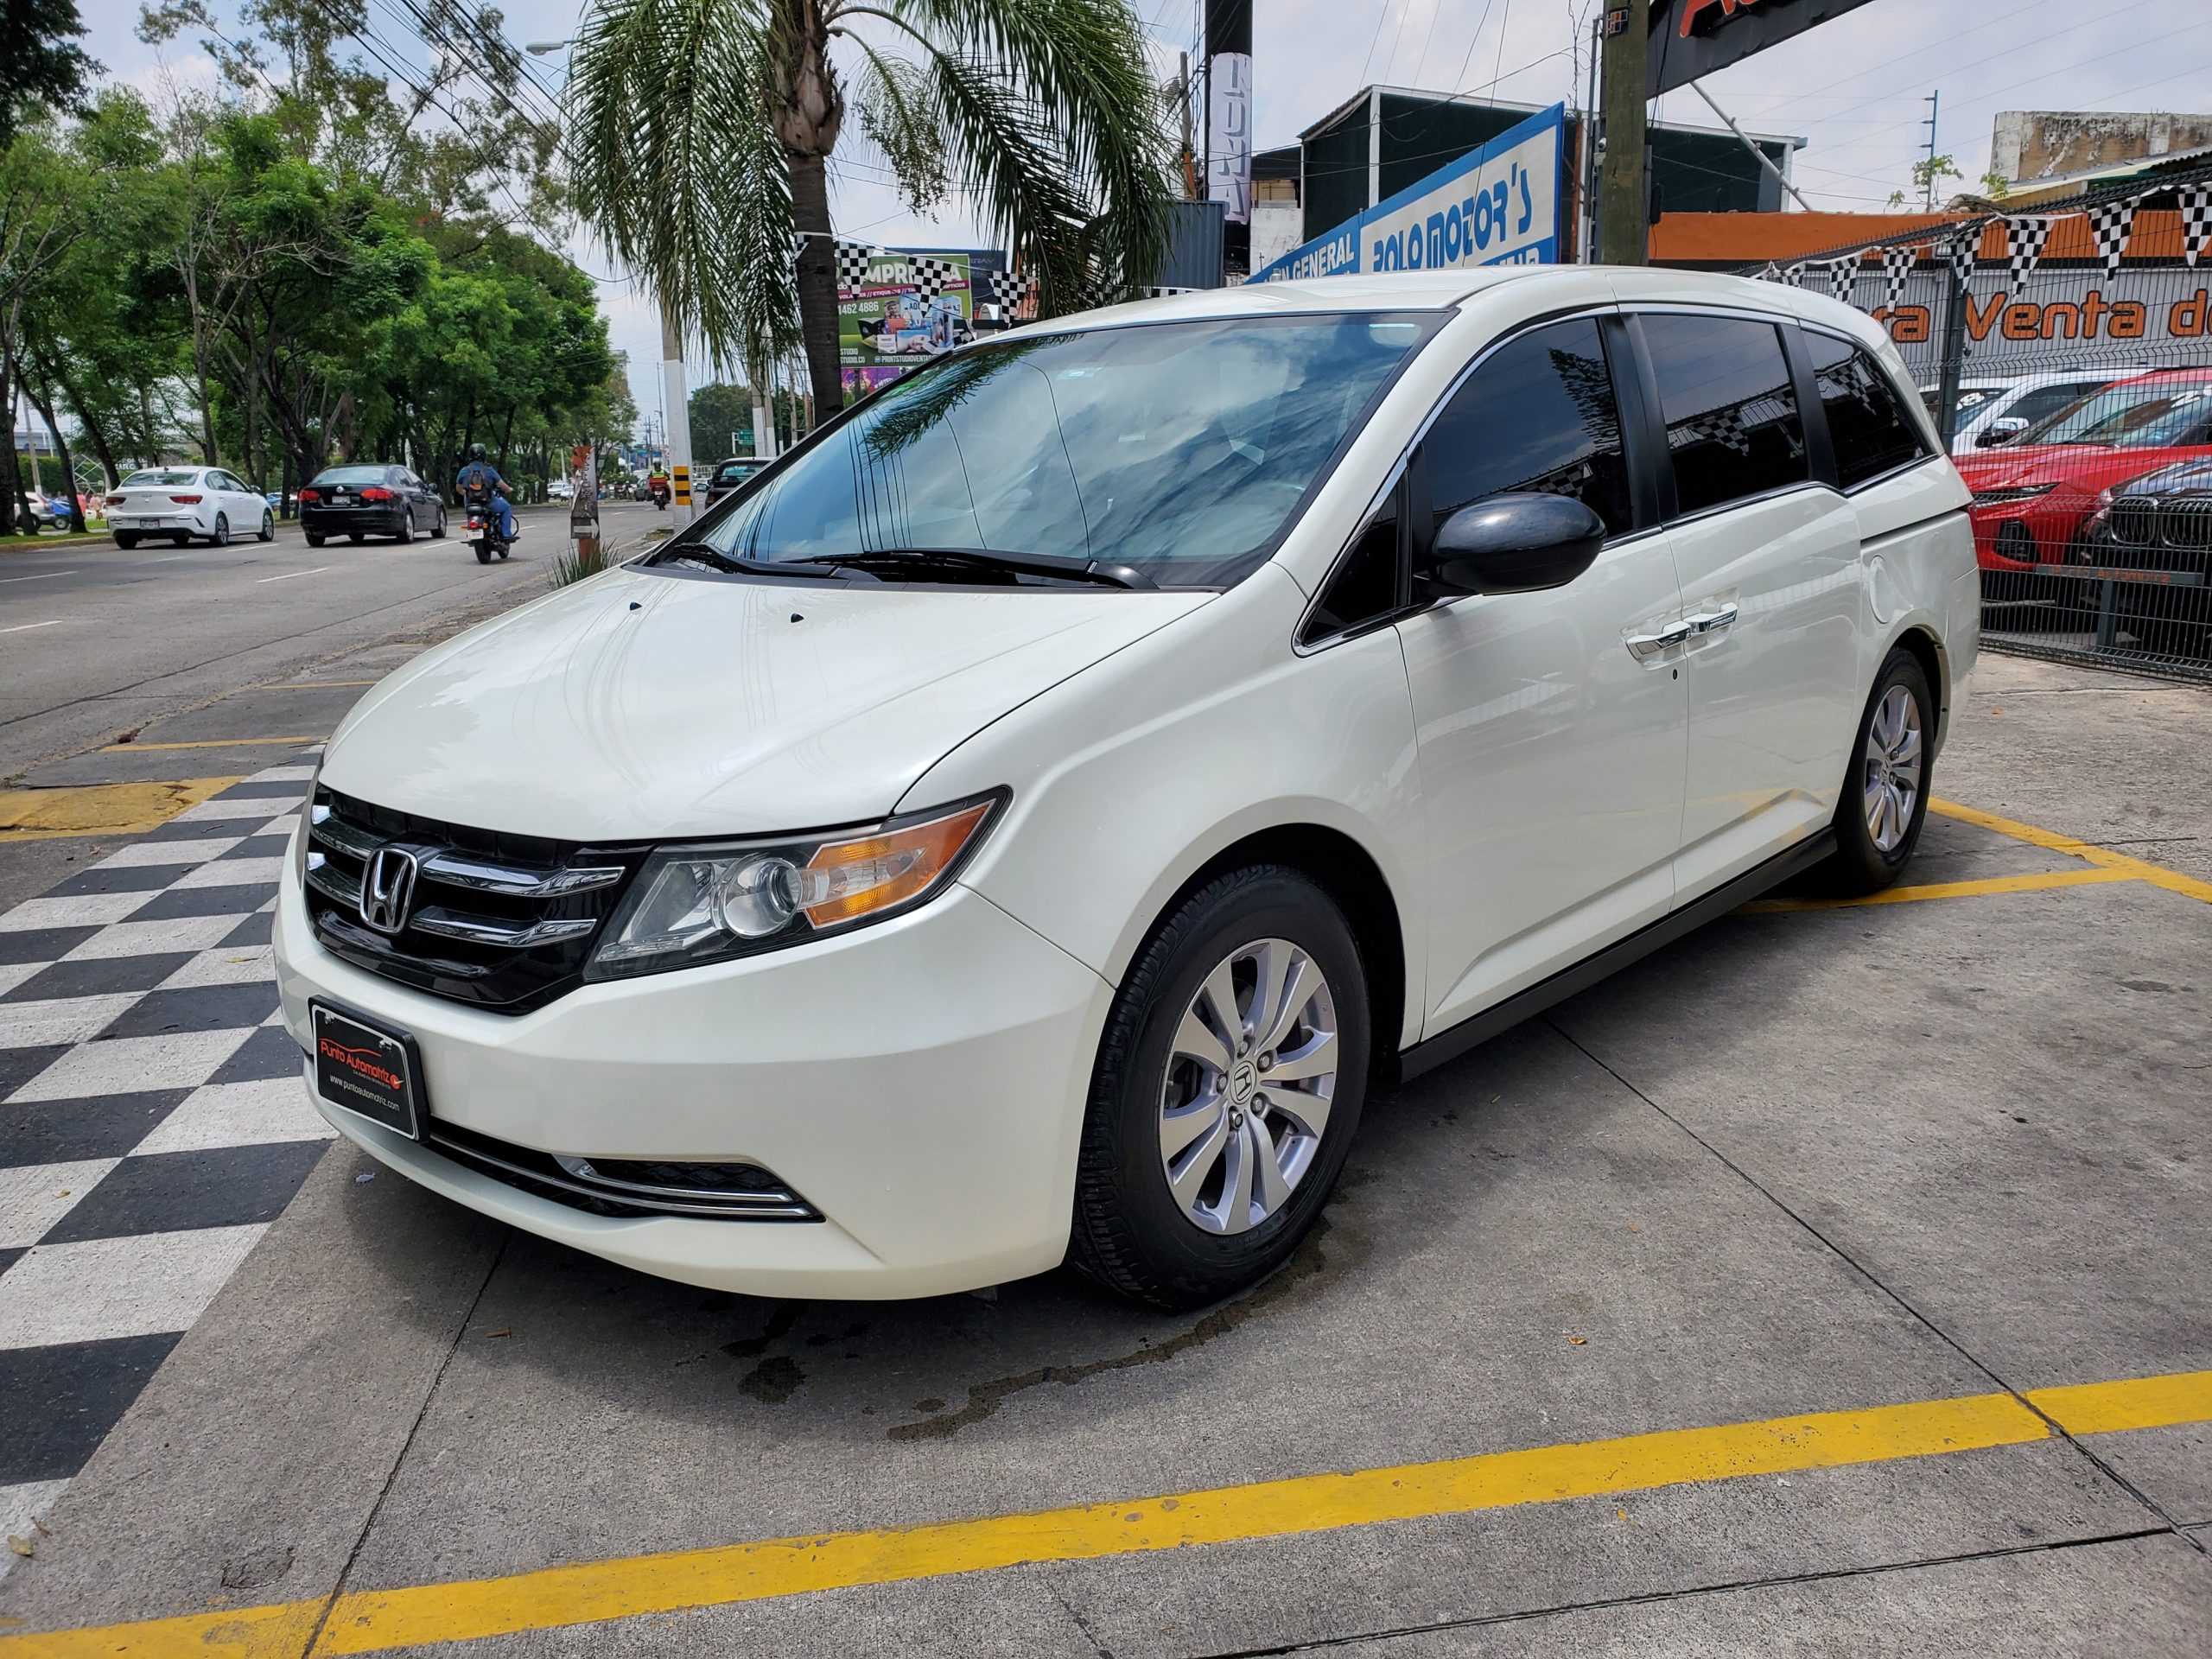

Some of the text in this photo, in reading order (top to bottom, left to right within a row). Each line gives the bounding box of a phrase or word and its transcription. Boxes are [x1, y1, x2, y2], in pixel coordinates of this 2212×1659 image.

[1292, 233, 1355, 280] GENERAL
[837, 301, 879, 315] 1462 4886
[1964, 289, 2146, 341] Venta
[2168, 289, 2212, 338] d
[321, 1041, 345, 1063] Punto
[346, 1053, 391, 1084] Automotriz
[329, 1074, 400, 1112] www.puntoautomotriz.com
